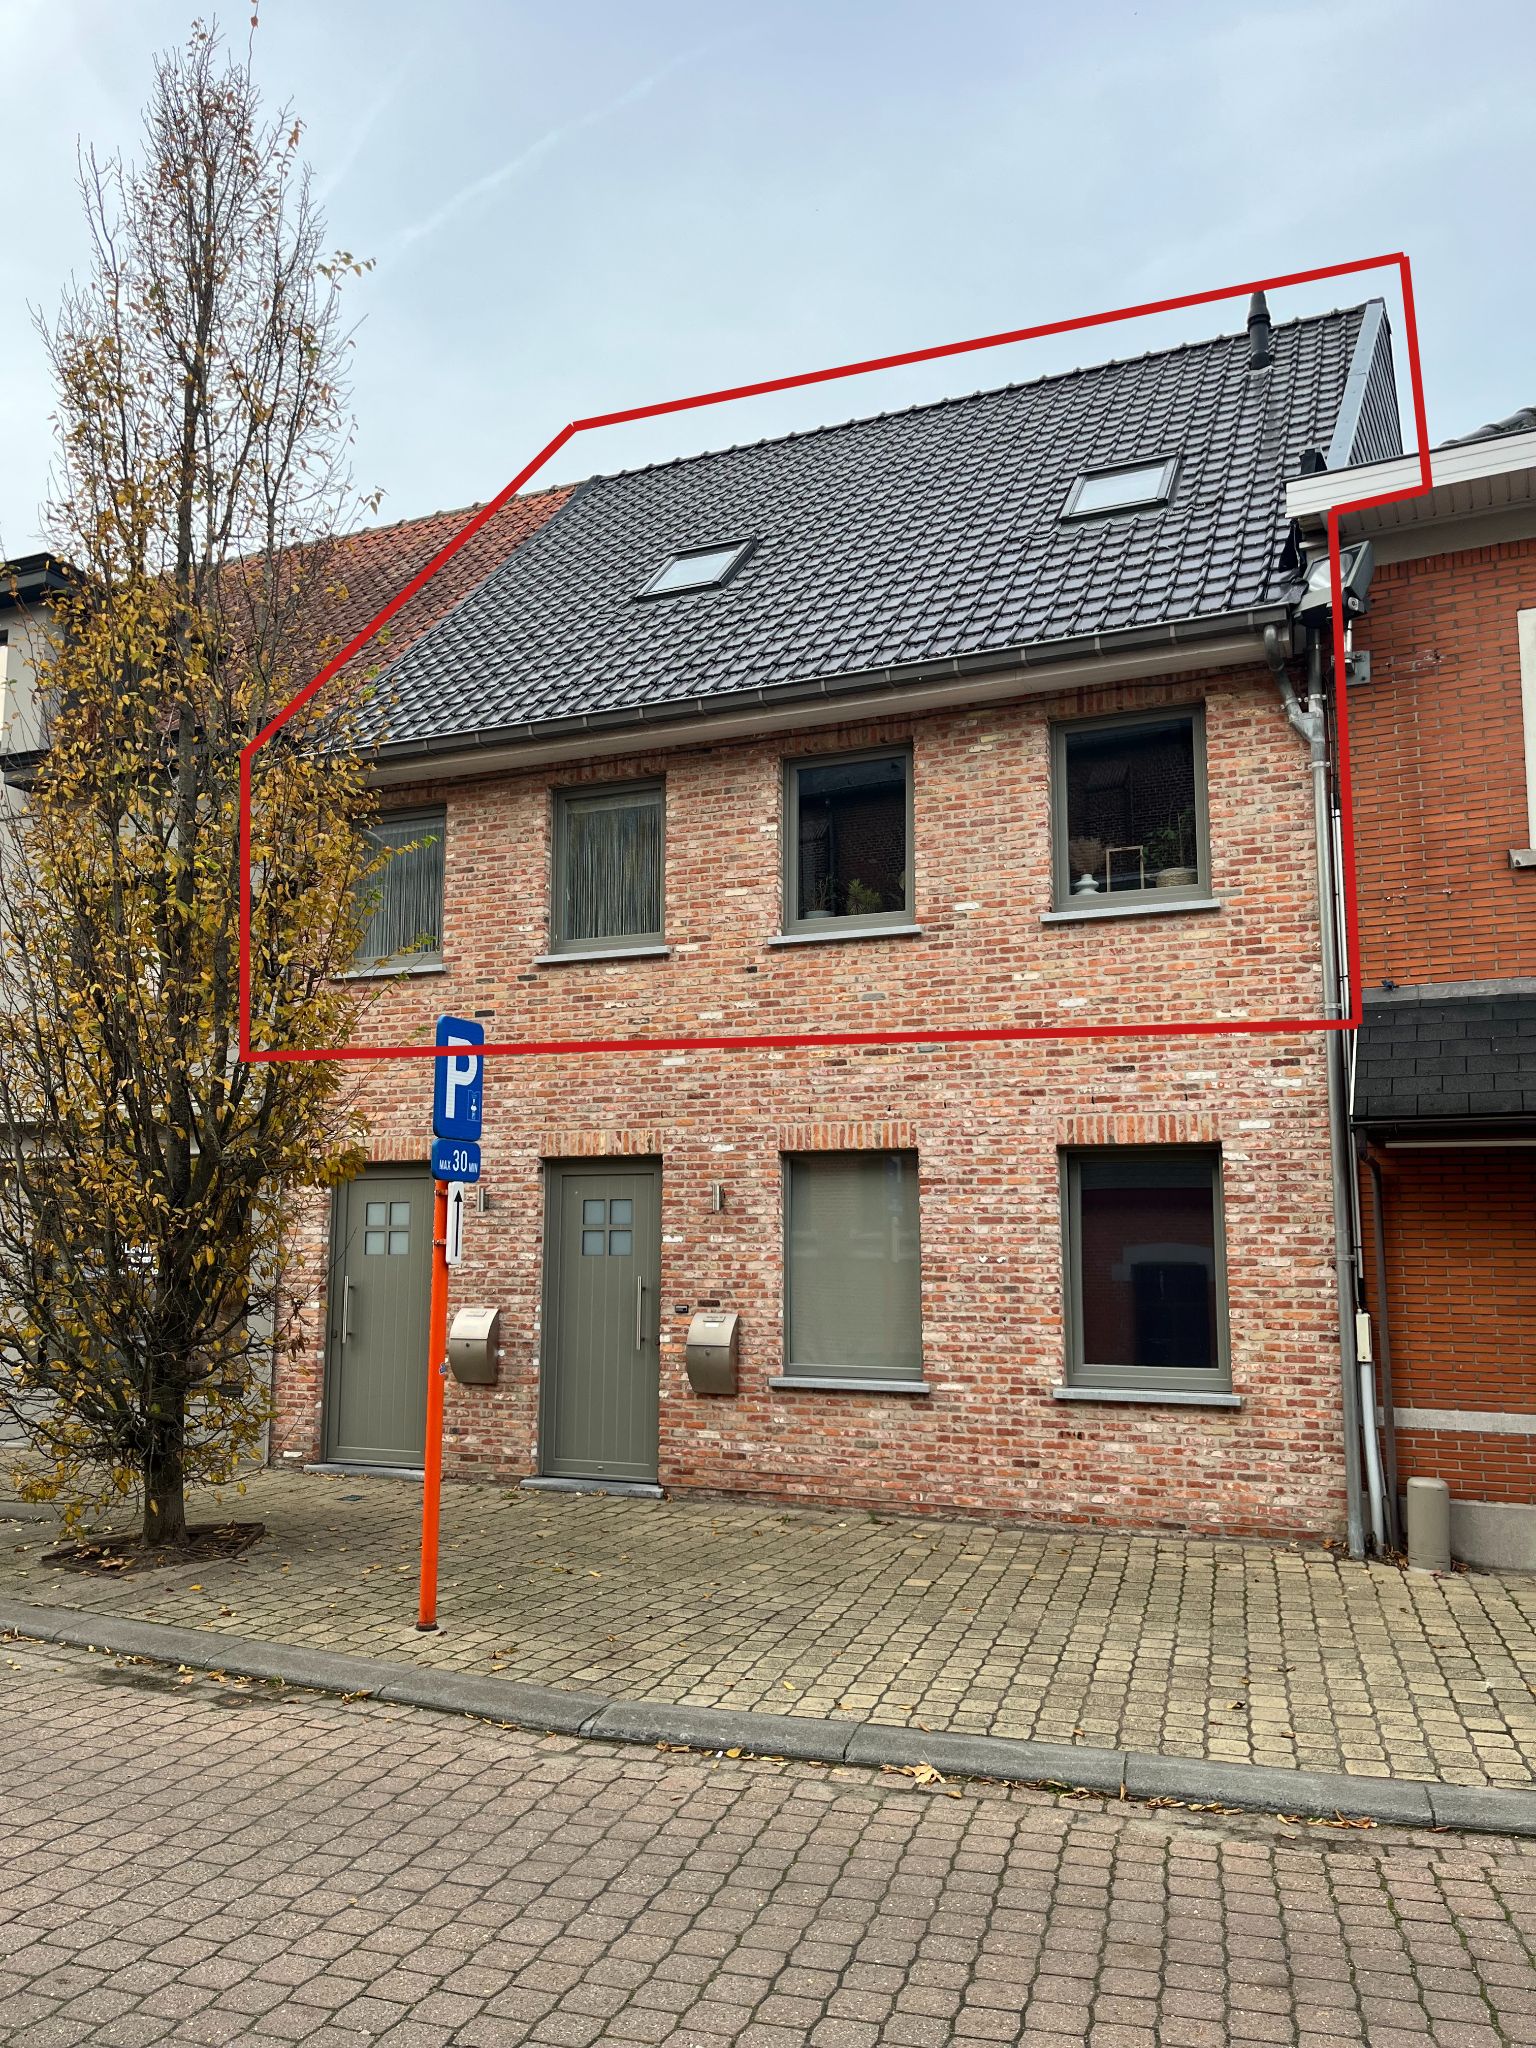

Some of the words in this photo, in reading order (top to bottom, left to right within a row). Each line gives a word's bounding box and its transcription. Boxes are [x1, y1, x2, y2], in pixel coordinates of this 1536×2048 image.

[445, 1036, 478, 1119] P
[439, 1159, 451, 1170] MAX
[453, 1149, 468, 1172] 30
[468, 1162, 478, 1173] MIN
